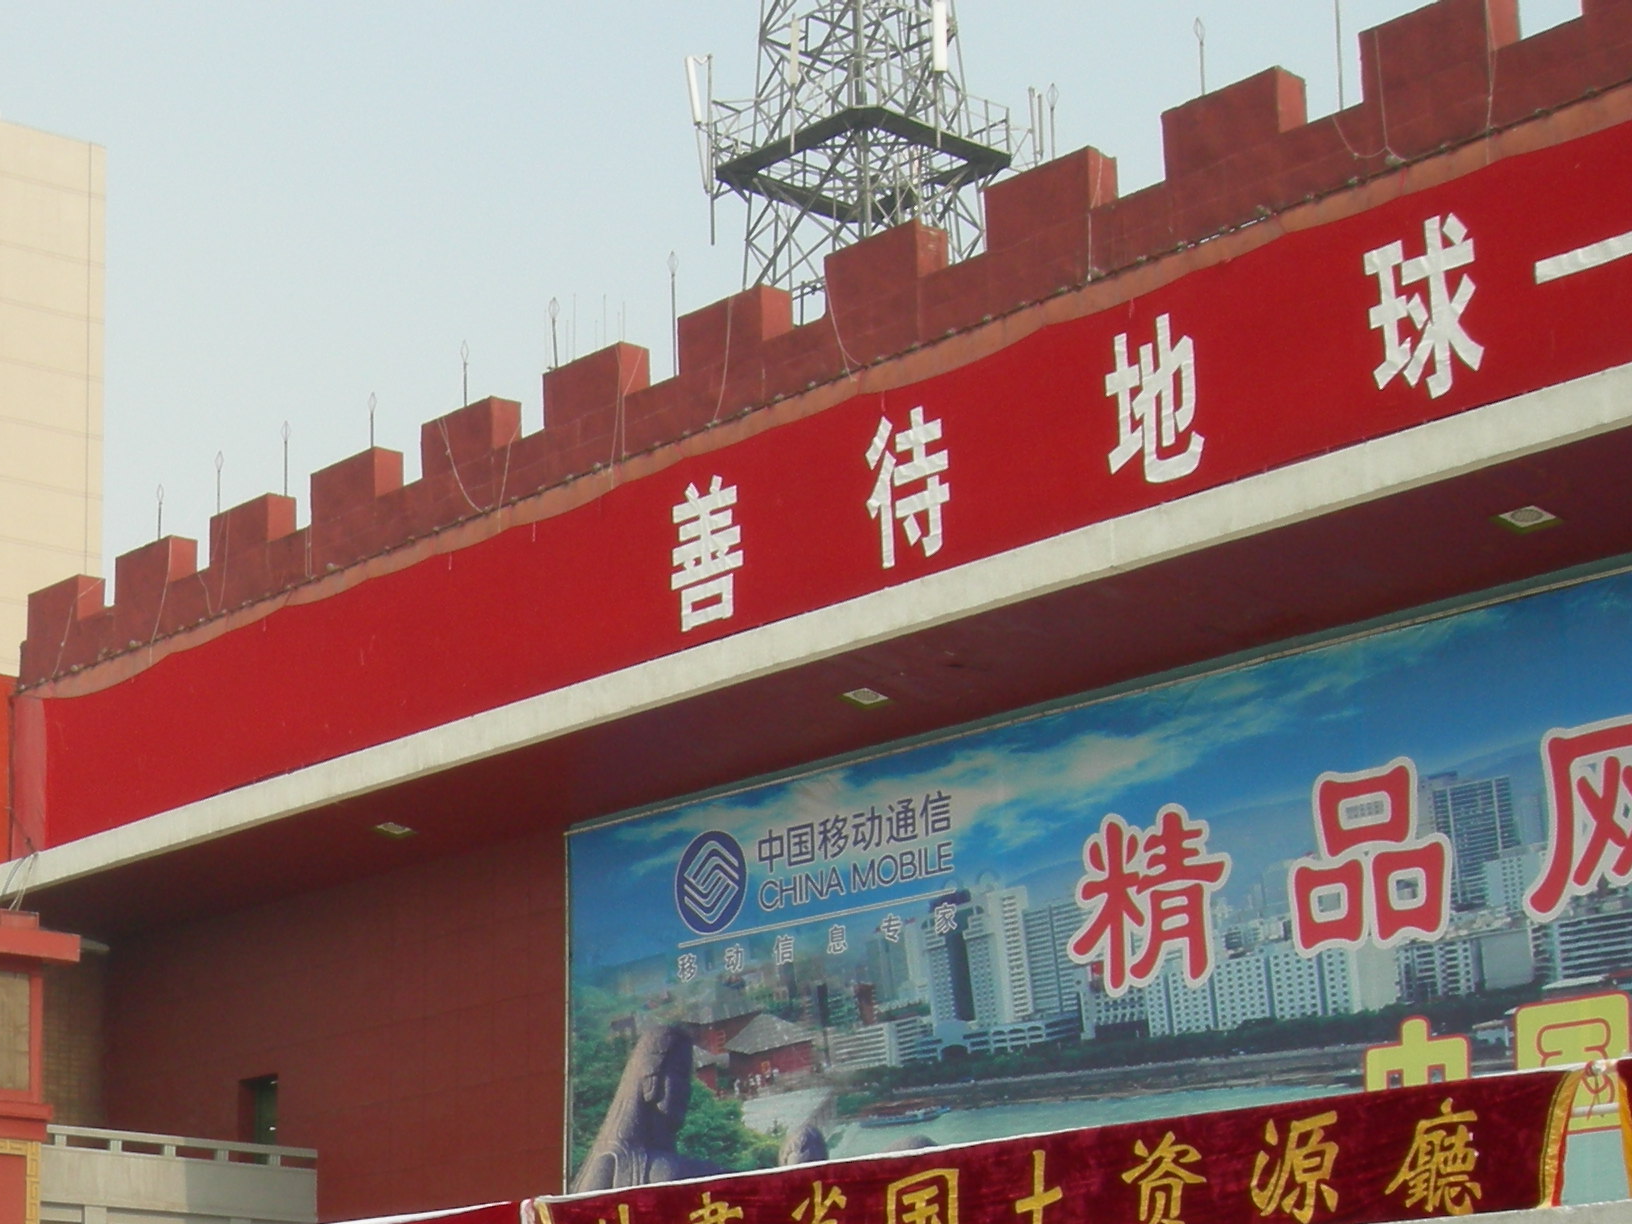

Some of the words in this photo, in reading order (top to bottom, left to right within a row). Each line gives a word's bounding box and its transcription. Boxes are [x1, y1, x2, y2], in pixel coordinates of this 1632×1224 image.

[757, 790, 953, 873] 中国移动通信
[759, 872, 846, 911] CHINA
[851, 841, 954, 893] MOBILE
[677, 902, 958, 983] 移动信息专家
